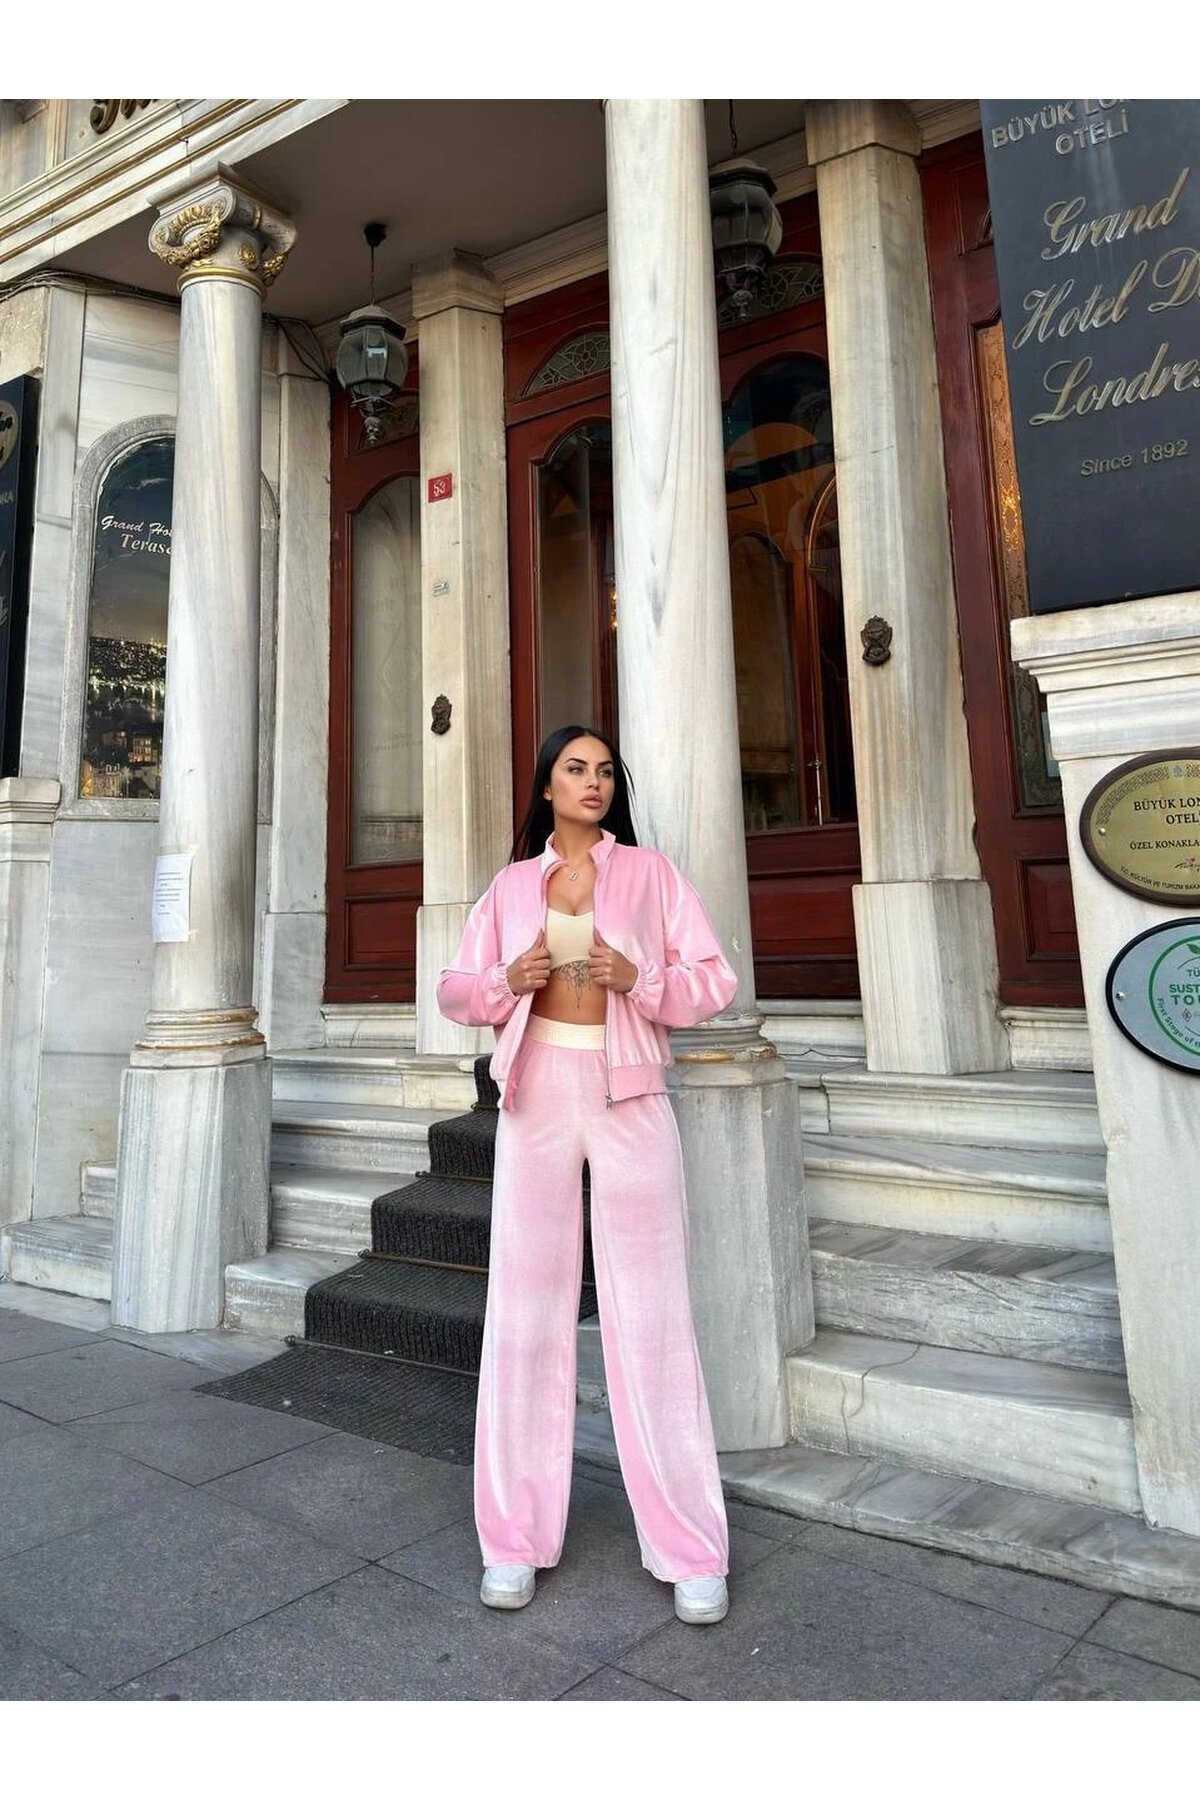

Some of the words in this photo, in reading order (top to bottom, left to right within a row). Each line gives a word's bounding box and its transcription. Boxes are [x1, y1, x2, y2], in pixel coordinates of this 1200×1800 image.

[991, 102, 1076, 149] BÜYÜK
[1055, 108, 1130, 155] OTELİ
[1040, 166, 1190, 261] Grand
[1011, 258, 1149, 350] Hotel
[1080, 453, 1133, 477] Since
[1140, 438, 1189, 464] 1892
[101, 515, 145, 532] Grand
[1133, 797, 1176, 811] BÜYÜK
[1129, 839, 1154, 851] ÖZEL
[1164, 1015, 1184, 1038] Stage
